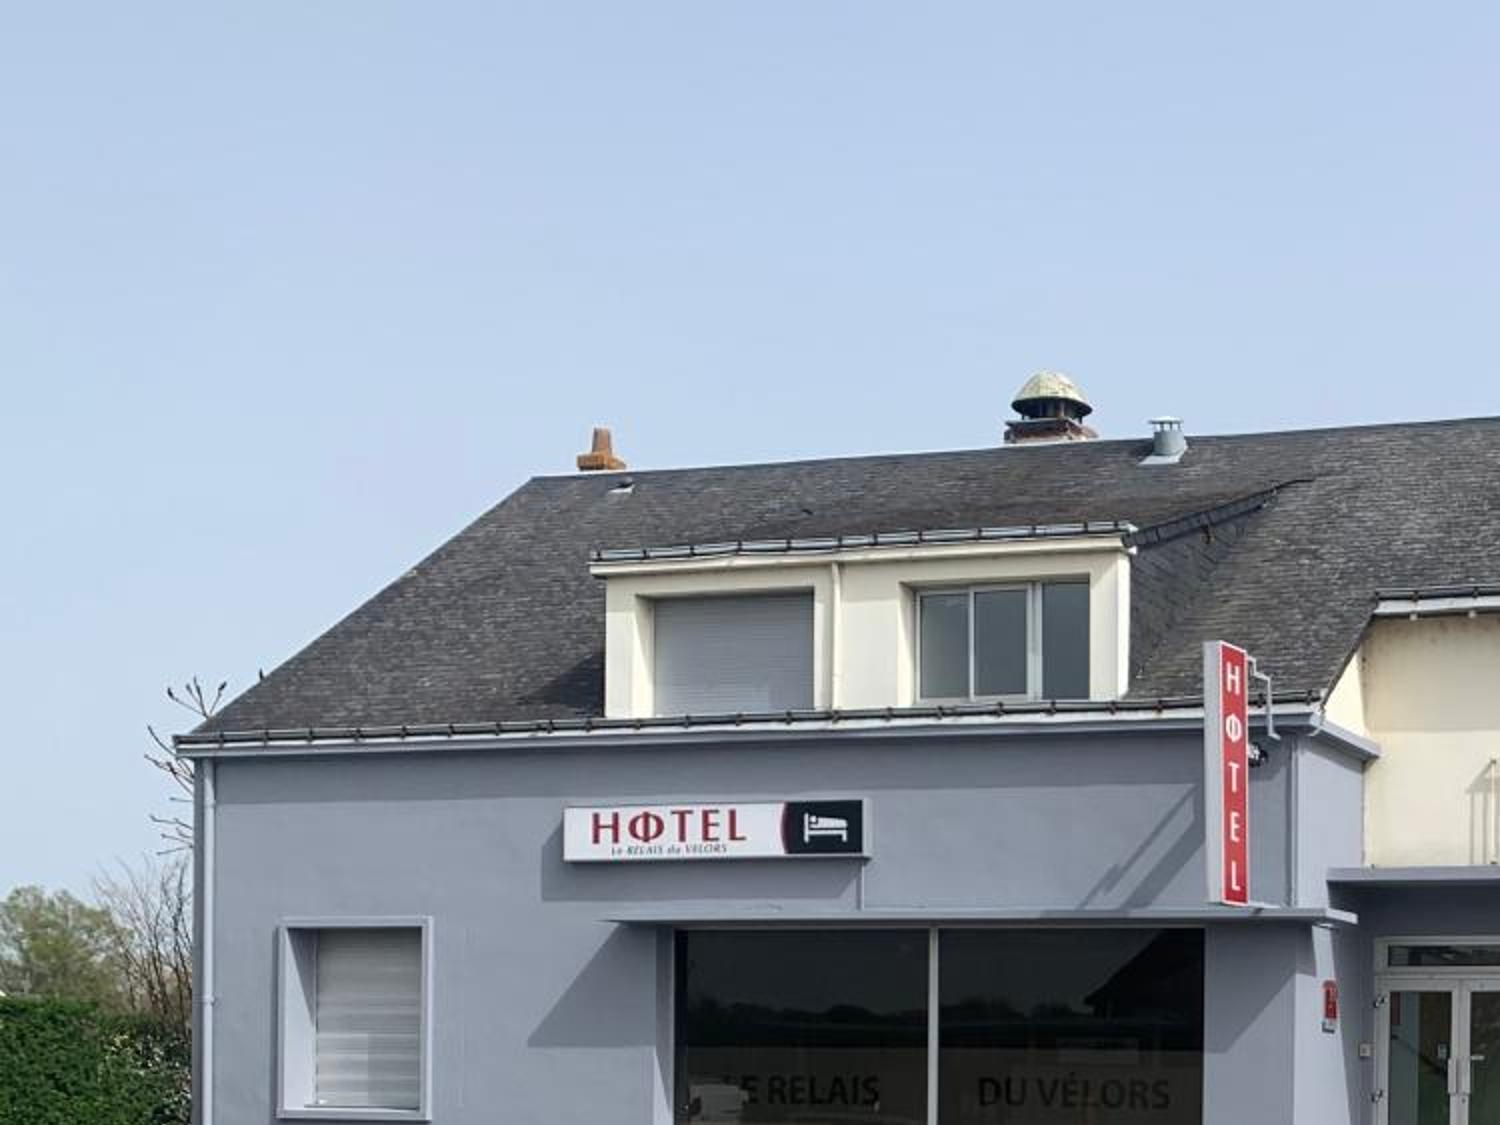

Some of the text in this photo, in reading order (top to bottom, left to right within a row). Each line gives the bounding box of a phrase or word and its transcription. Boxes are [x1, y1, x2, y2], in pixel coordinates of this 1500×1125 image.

[768, 1075, 881, 1106] RELAIS
[978, 1076, 1025, 1107] DU
[1036, 1071, 1170, 1110] VÉLORS
